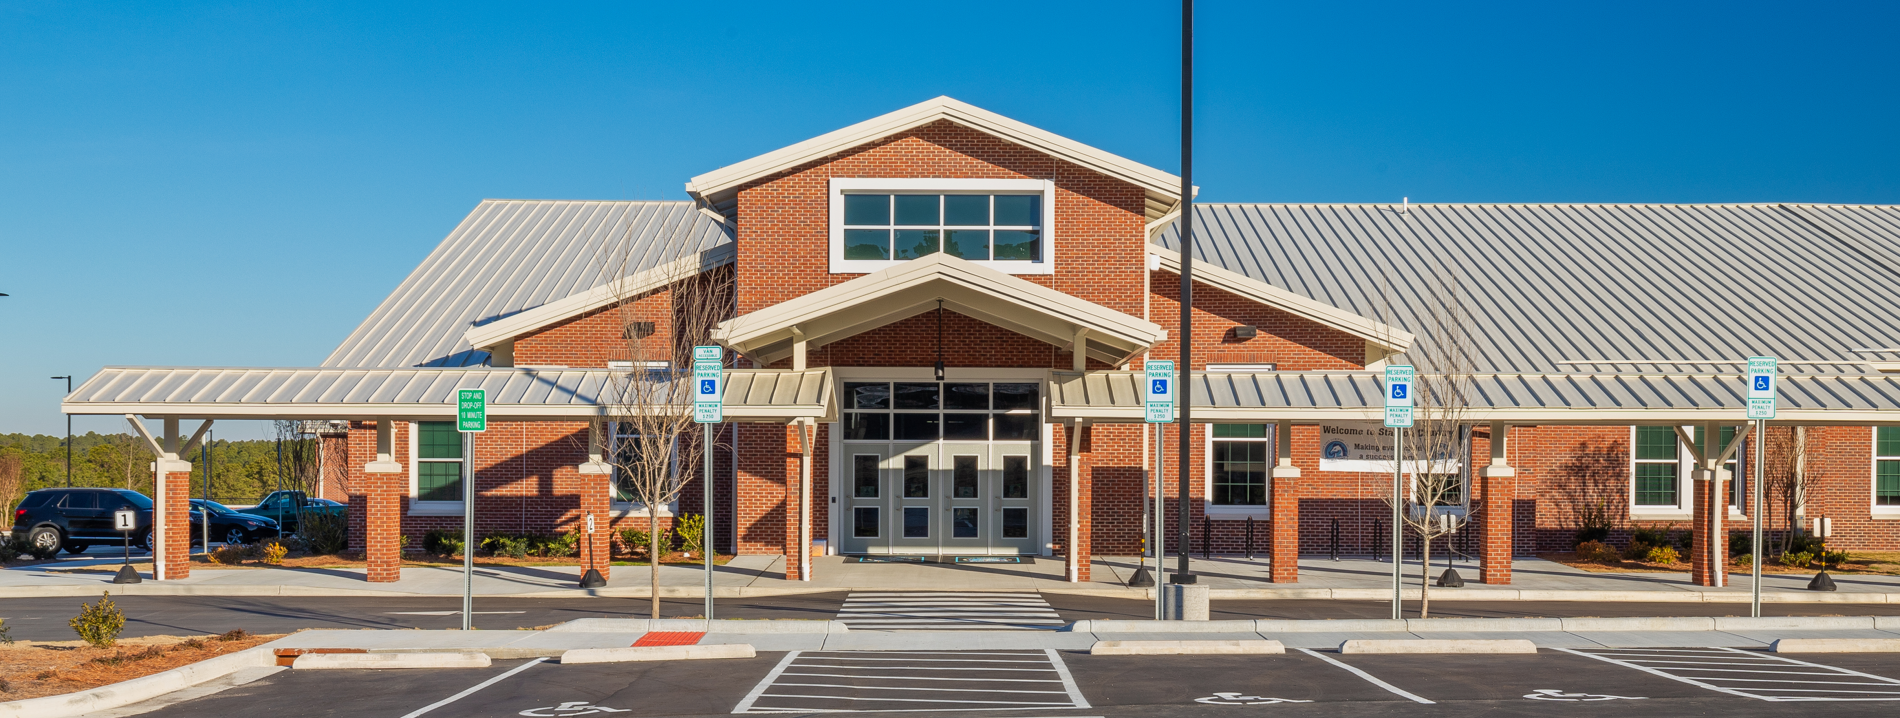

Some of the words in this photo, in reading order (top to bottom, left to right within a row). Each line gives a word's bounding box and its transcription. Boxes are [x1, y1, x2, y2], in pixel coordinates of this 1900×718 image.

[1323, 426, 1363, 435] Welcome
[1354, 443, 1379, 452] Making
[121, 514, 128, 526] 1
[589, 518, 593, 530] 2
